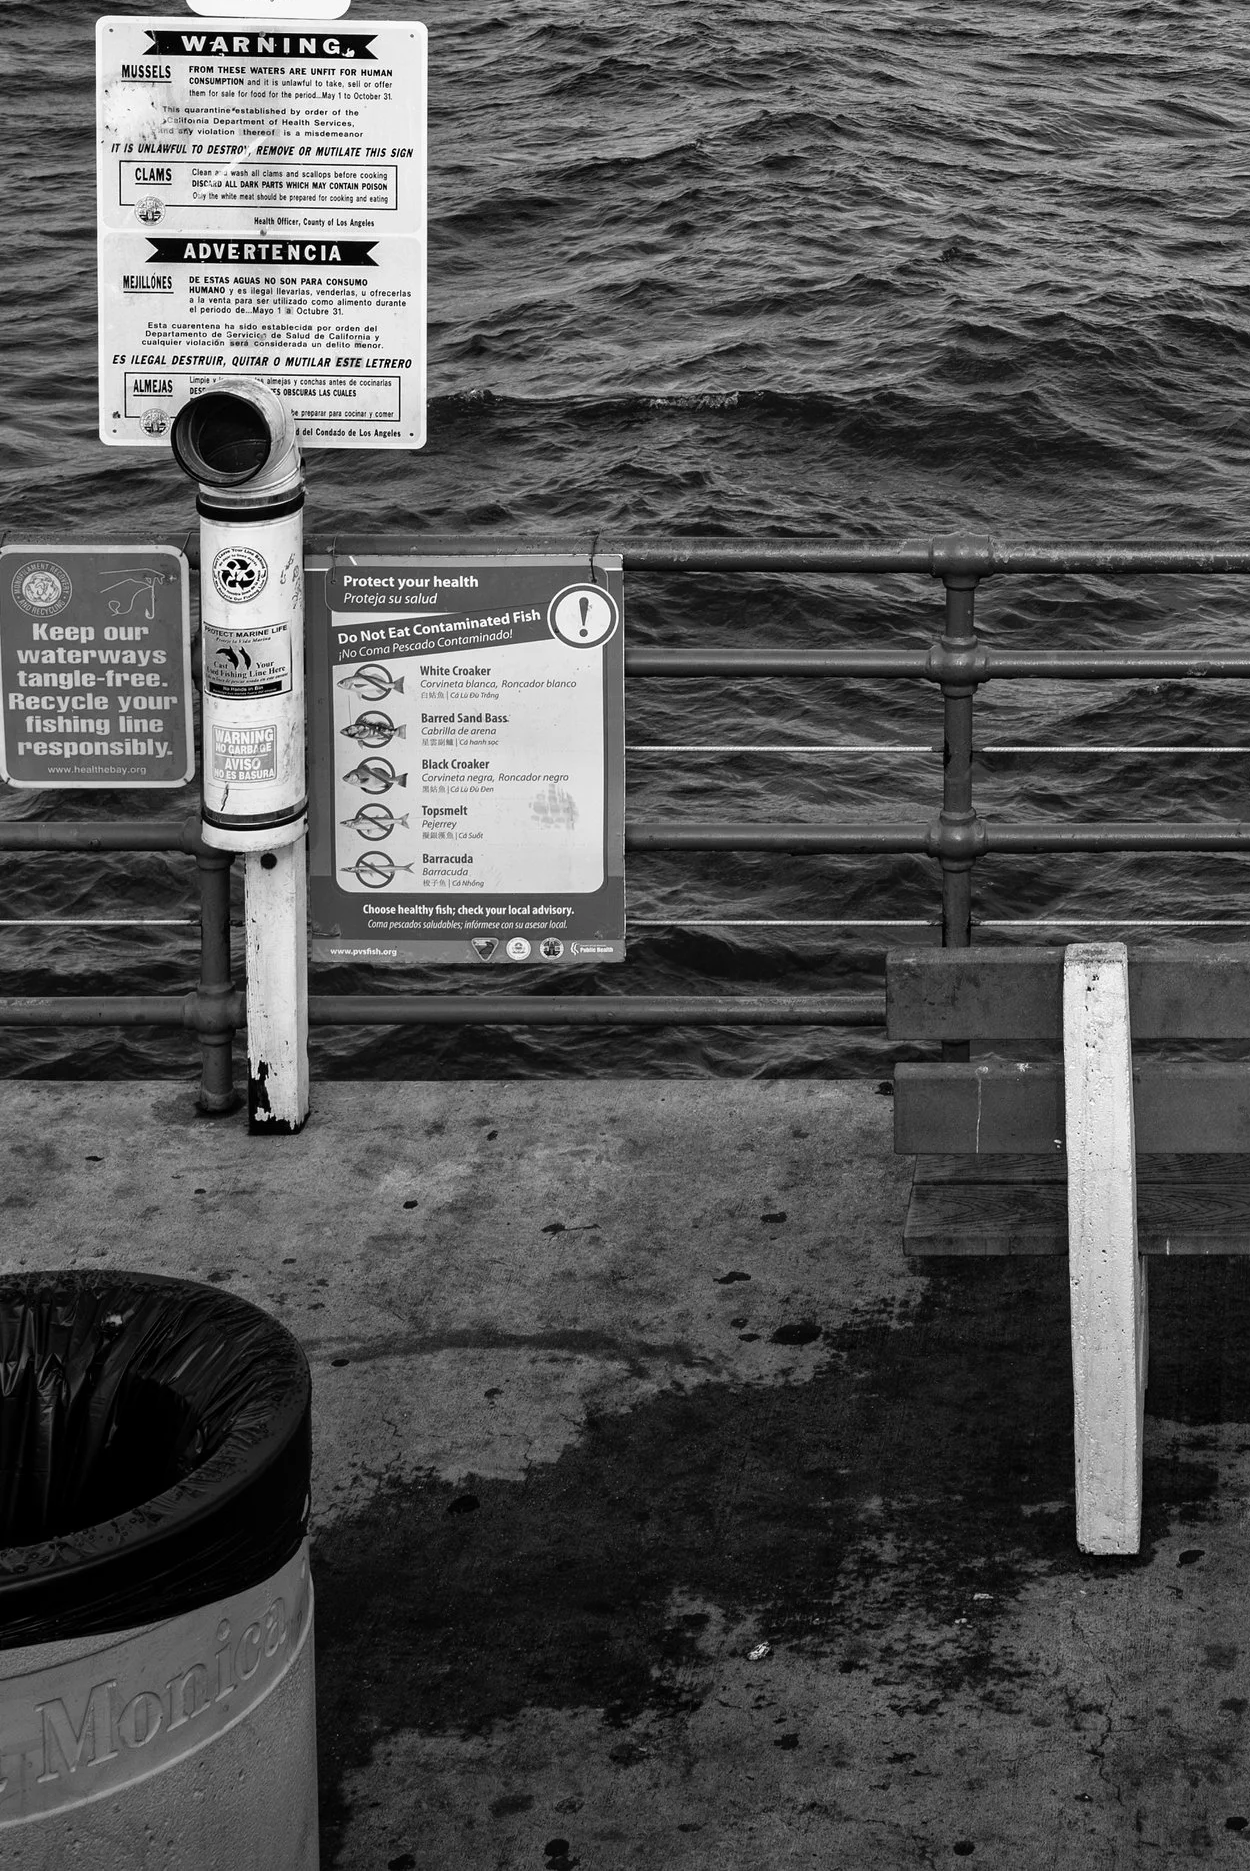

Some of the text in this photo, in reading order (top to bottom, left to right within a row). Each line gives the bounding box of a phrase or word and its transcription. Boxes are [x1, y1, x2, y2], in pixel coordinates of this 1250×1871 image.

[181, 35, 339, 54] WARNING
[122, 65, 171, 79] MUSSELS
[217, 66, 246, 74] THESE
[250, 67, 285, 75] WATERS
[311, 68, 336, 76] UNFIT
[340, 68, 357, 76] FOR
[361, 69, 392, 77] HUMAN
[111, 143, 121, 153] IT
[124, 143, 134, 153] IS
[138, 143, 187, 154] UNLAWFUL
[192, 144, 203, 154] TO
[256, 145, 295, 156] REMOVE
[299, 146, 312, 156] OR
[315, 147, 362, 157] MUTILATE
[366, 147, 387, 157] THIS
[390, 148, 413, 158] SIGN
[135, 167, 172, 181] CLAMS
[254, 217, 374, 228] Health Officer, County of Los Angeles
[184, 243, 341, 261] ADVERTENCIA
[204, 276, 230, 284] ESTAS
[264, 277, 276, 285] NO
[280, 277, 297, 285] SON
[326, 278, 368, 286] CONSUMO
[112, 355, 412, 369] ES ILEGAL DESTRUIR, QUITAR O MUTILAR ESTE LETRERO
[133, 379, 173, 393] ALMEJAS
[14, 563, 69, 594] MONOFILAMENT RECOVERY
[344, 575, 478, 590] Protect your health
[344, 592, 438, 606] Proteja su salud
[19, 600, 65, 615] AND RECYCLING
[33, 623, 149, 643] Keep our
[205, 626, 233, 637] PROTECT
[272, 625, 287, 633] LIFE
[338, 609, 541, 644] Do Not Eat Contaminated Fish
[339, 629, 514, 661] ¡No Coma Pescado Contaminado!
[17, 647, 166, 667] waterways
[420, 665, 491, 676] White Croaker
[17, 670, 168, 690] tangle-free.
[420, 679, 577, 689] Corvineta blanca, Roncador blanco
[9, 693, 177, 713] Recycle your
[421, 713, 455, 723] Barred
[457, 713, 482, 723] Sand
[25, 716, 163, 735] fishing line
[421, 726, 456, 735] Cabrilla
[457, 726, 469, 735] de
[215, 729, 273, 744] WARNING
[18, 738, 172, 758] responsibly.
[216, 742, 271, 754] NO GARBAGE
[48, 765, 146, 775] www.healthebay.org
[225, 758, 260, 770] AVISO
[422, 759, 490, 769] Black Croaker
[227, 771, 236, 779] ES
[239, 768, 274, 779] BASURA
[422, 773, 569, 784] Corvineta negra, Roncador negro
[422, 805, 468, 818] Topsmelt
[422, 820, 457, 830] Pejerrey
[423, 853, 473, 864] Barracuda
[422, 867, 468, 876] Barracuda
[363, 904, 574, 917] Choose healthy fish; check your local advisory.
[368, 919, 388, 928] Coma
[389, 920, 422, 930] pescados
[423, 920, 463, 930] saludables;
[464, 920, 500, 929] infórmese
[549, 920, 567, 929] local.
[330, 948, 397, 957] www.pvsfish.org
[34, 1597, 287, 1783] Monica
